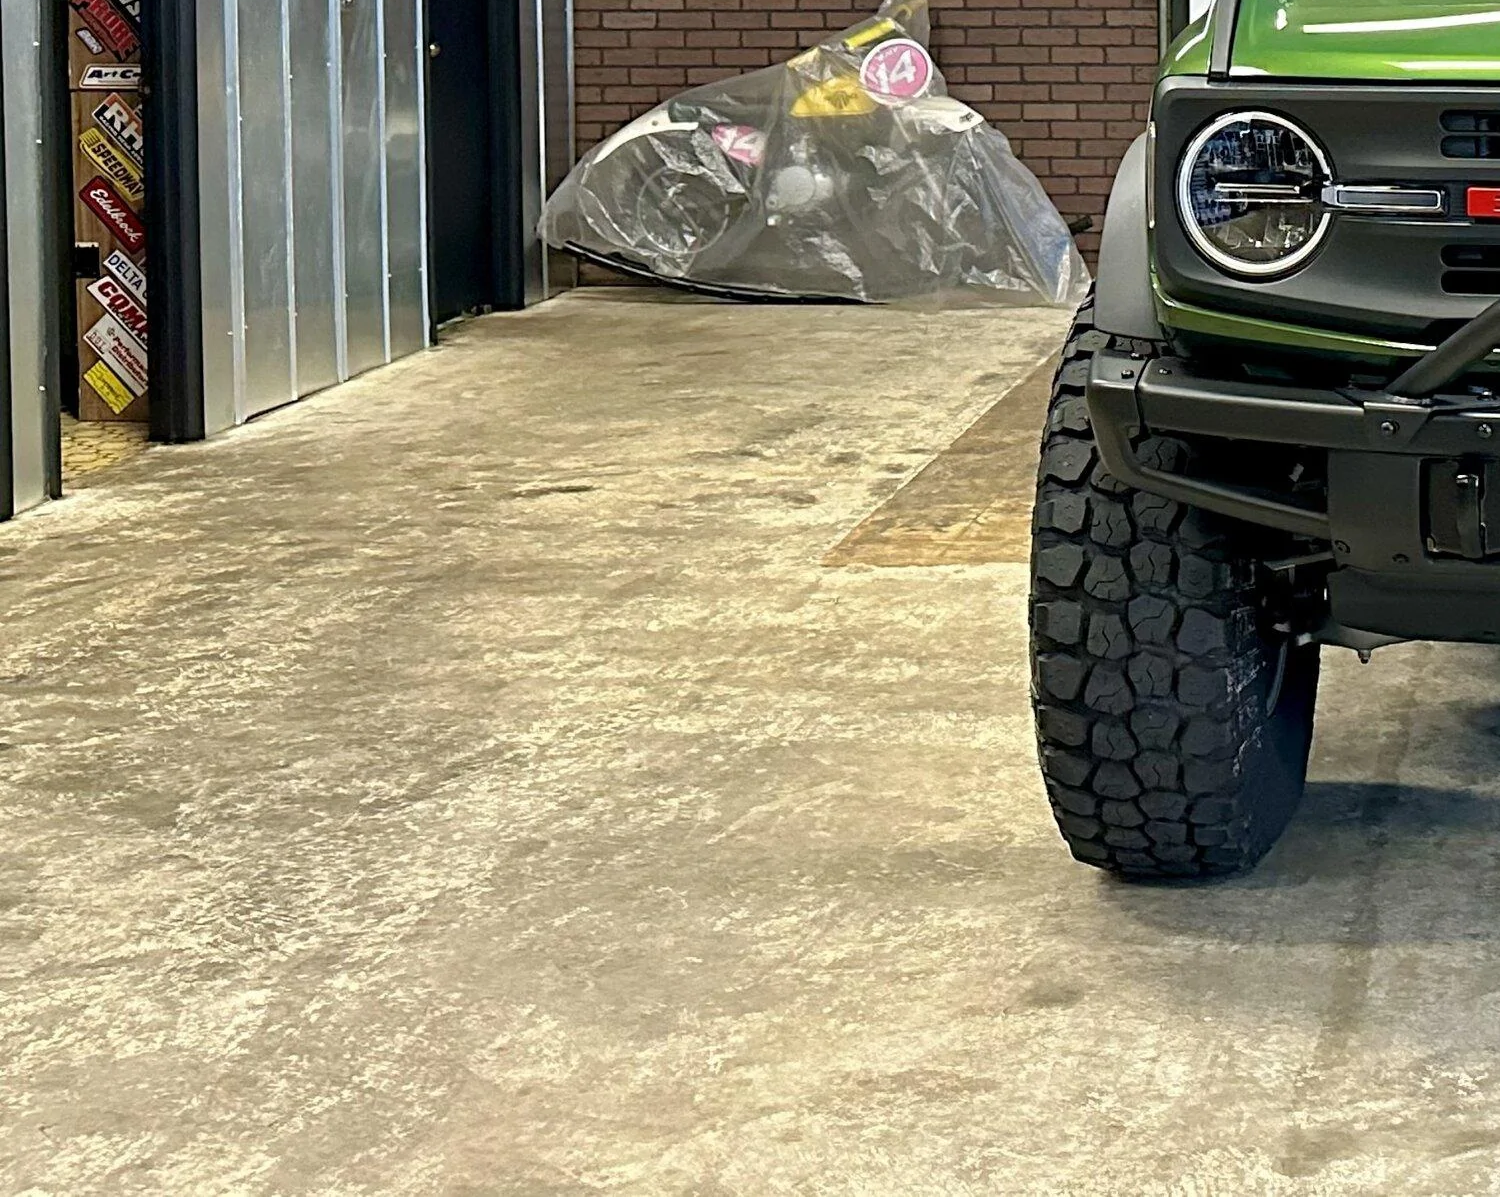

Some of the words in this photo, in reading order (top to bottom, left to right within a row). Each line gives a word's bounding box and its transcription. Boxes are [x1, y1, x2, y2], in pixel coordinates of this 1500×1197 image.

[91, 143, 143, 196] SPEEDWAY
[90, 189, 143, 242] Edelbrock
[108, 254, 143, 290] DELTA
